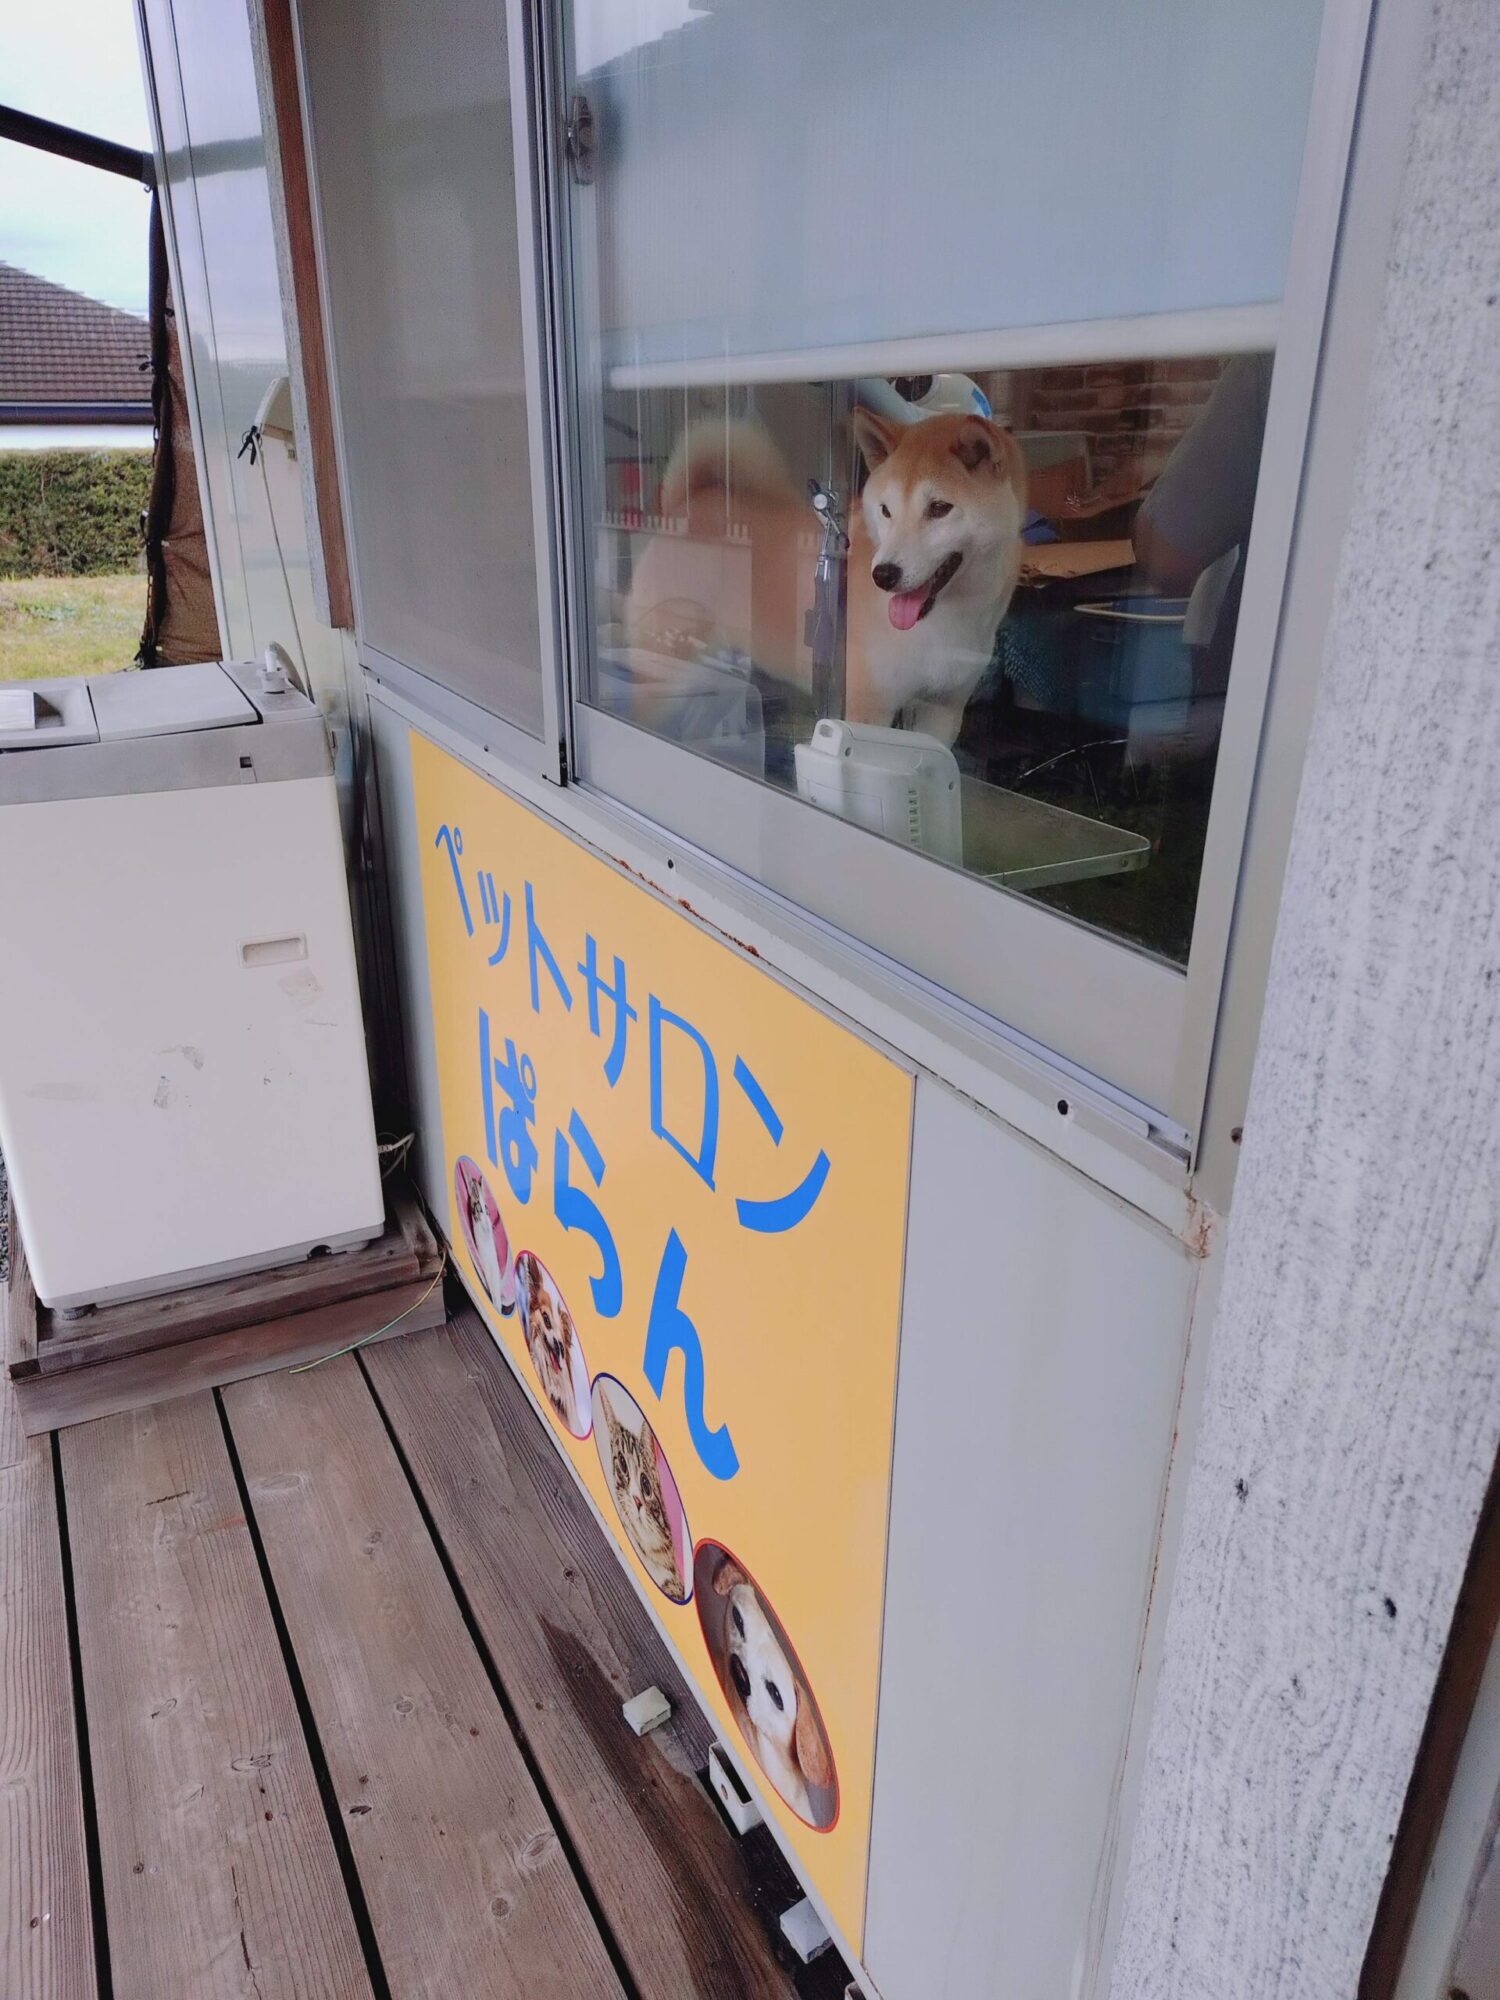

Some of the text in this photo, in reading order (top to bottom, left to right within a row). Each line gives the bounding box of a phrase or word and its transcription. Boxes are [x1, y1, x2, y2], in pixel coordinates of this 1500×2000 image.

[435, 824, 830, 1232] ペットサロン
[479, 1007, 740, 1480] ぱらん
